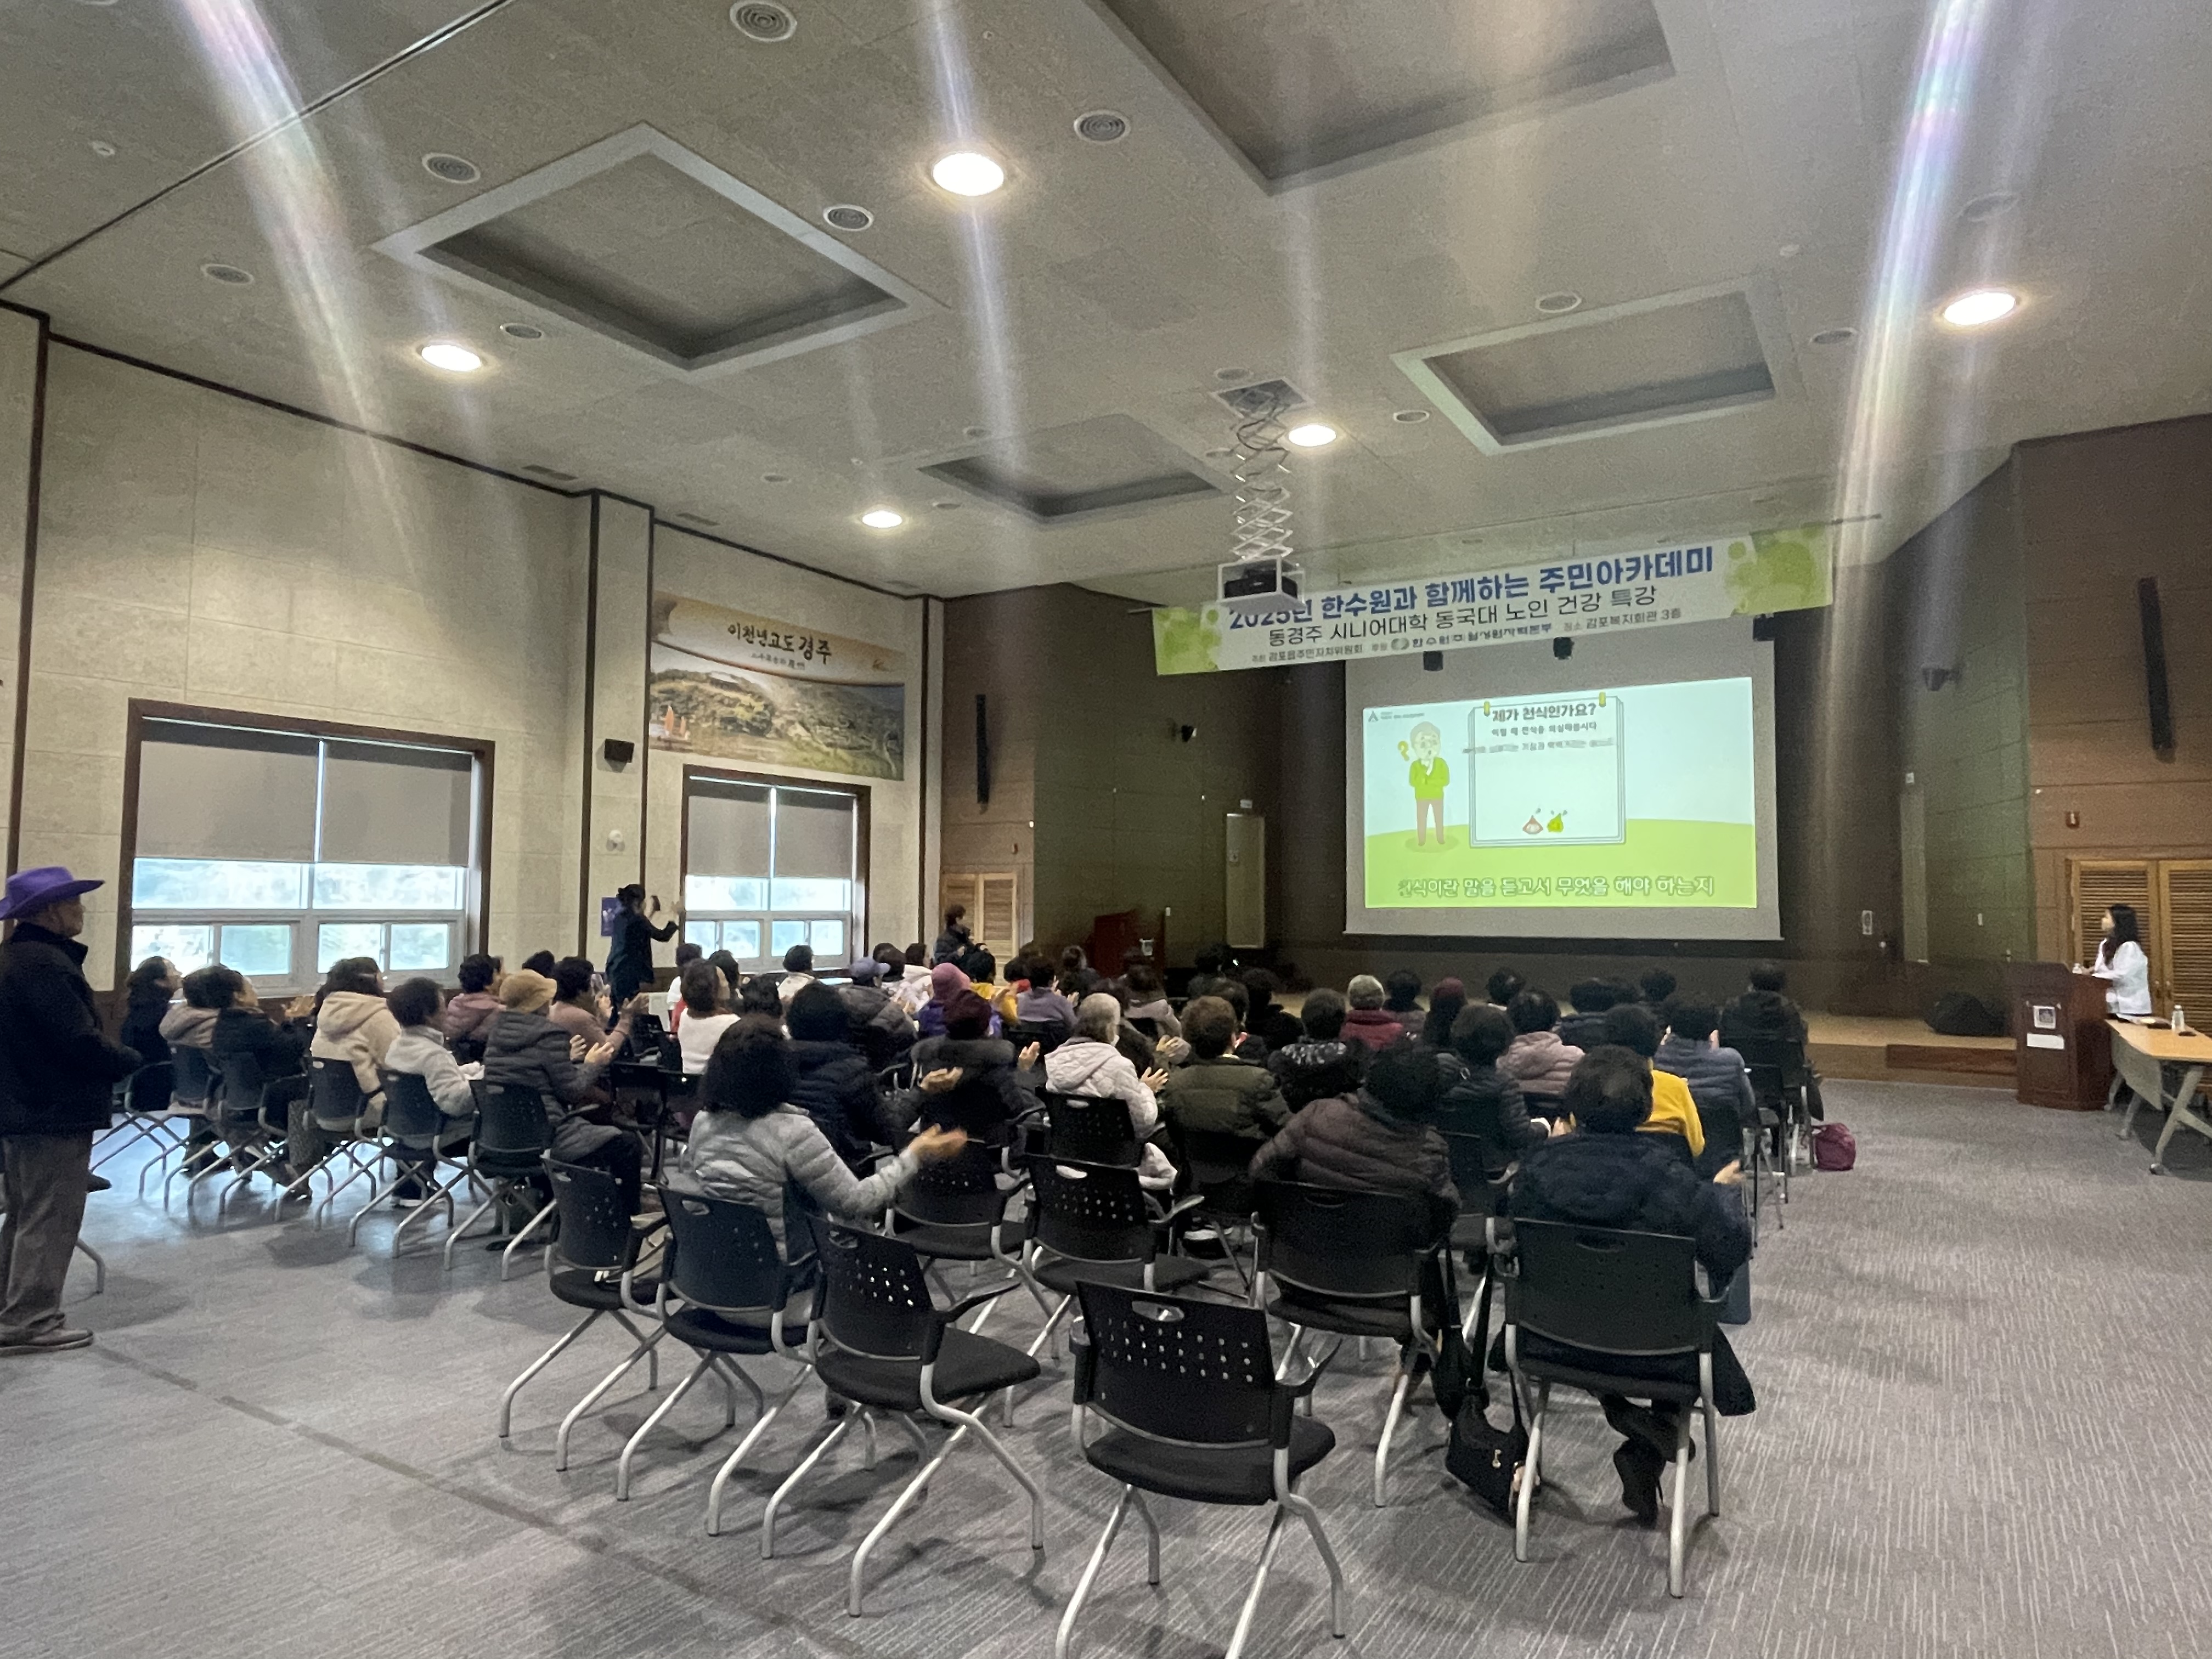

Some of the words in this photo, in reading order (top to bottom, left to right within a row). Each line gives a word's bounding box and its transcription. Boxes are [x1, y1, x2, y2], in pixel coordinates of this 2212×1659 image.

[1321, 585, 1418, 619] 한수원과
[1425, 573, 1529, 607] 함께하는
[1539, 546, 1713, 593] 주민아카데미
[1269, 625, 1322, 646] 동경주
[1330, 613, 1427, 640] 시니어대학
[1436, 605, 1498, 630] 동국대
[1505, 599, 1548, 621] 노인
[1558, 592, 1601, 615] 건강
[1611, 585, 1657, 607] 특강
[798, 634, 832, 665] 경주
[1492, 708, 1519, 722] 제가
[1555, 876, 1610, 896] 무엇을
[1613, 876, 1652, 896] 해야
[1655, 875, 1715, 897] 하는지
